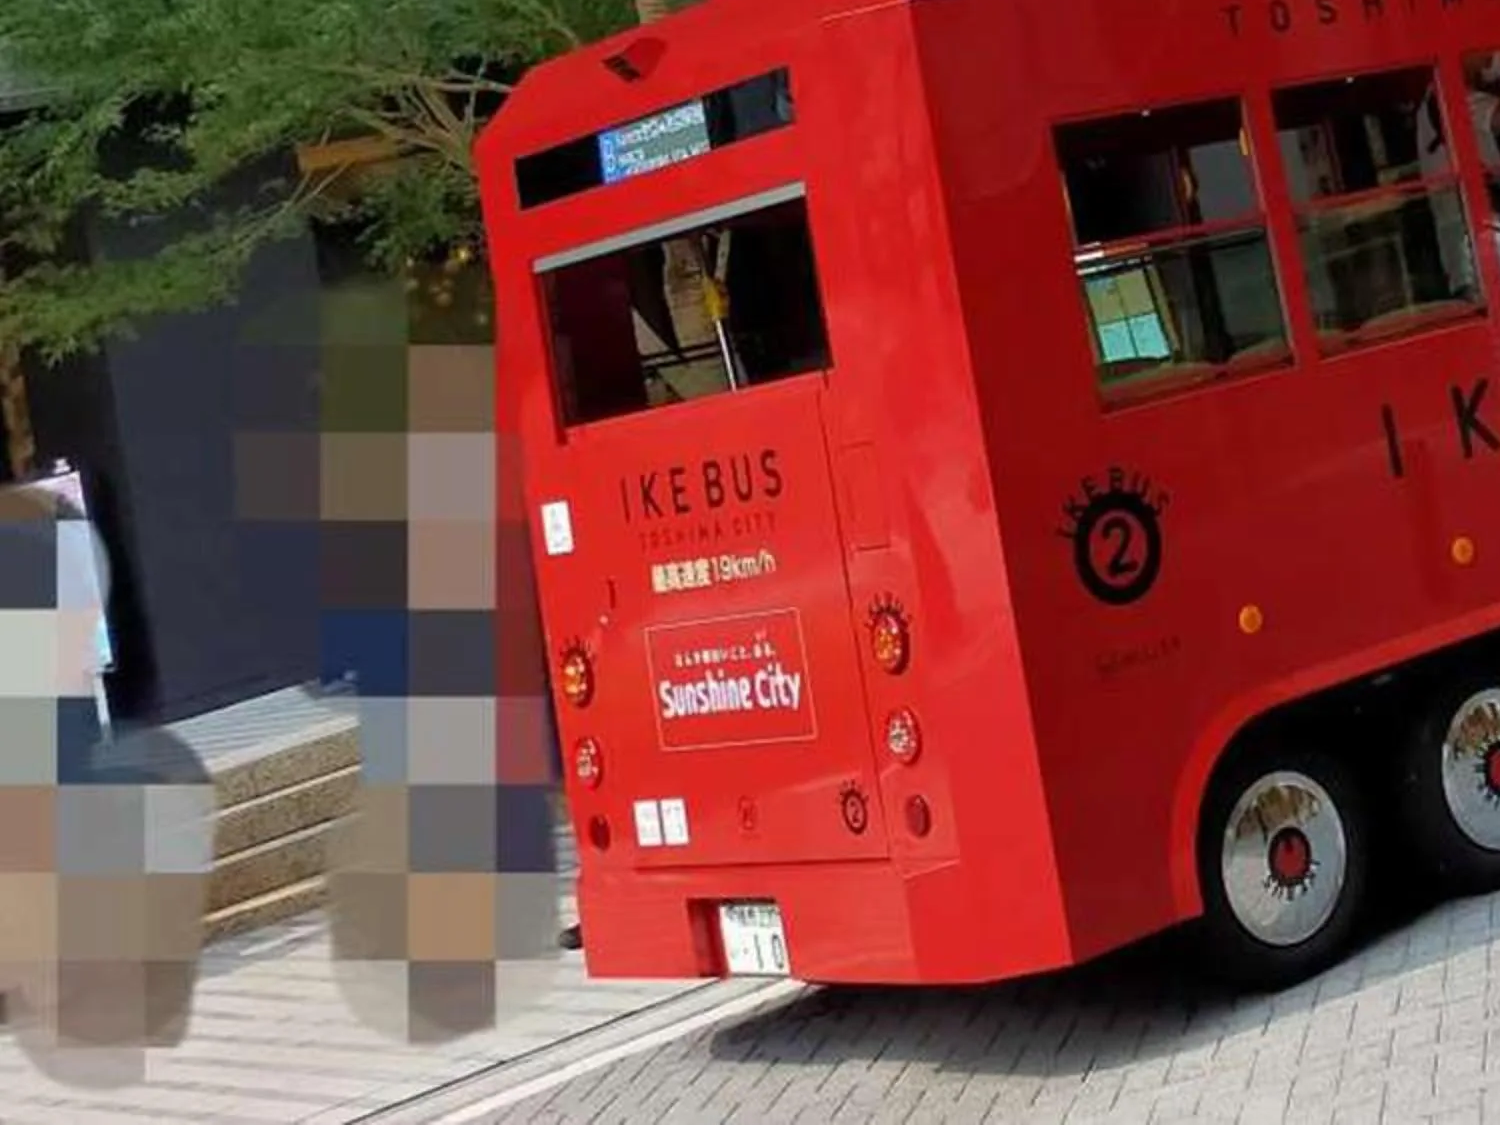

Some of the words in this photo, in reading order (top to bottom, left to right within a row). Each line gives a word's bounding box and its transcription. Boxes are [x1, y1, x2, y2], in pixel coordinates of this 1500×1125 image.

[620, 448, 783, 524] IKEBUS
[1101, 516, 1139, 577] 2
[658, 668, 753, 719] Sunshine
[753, 662, 801, 710] City
